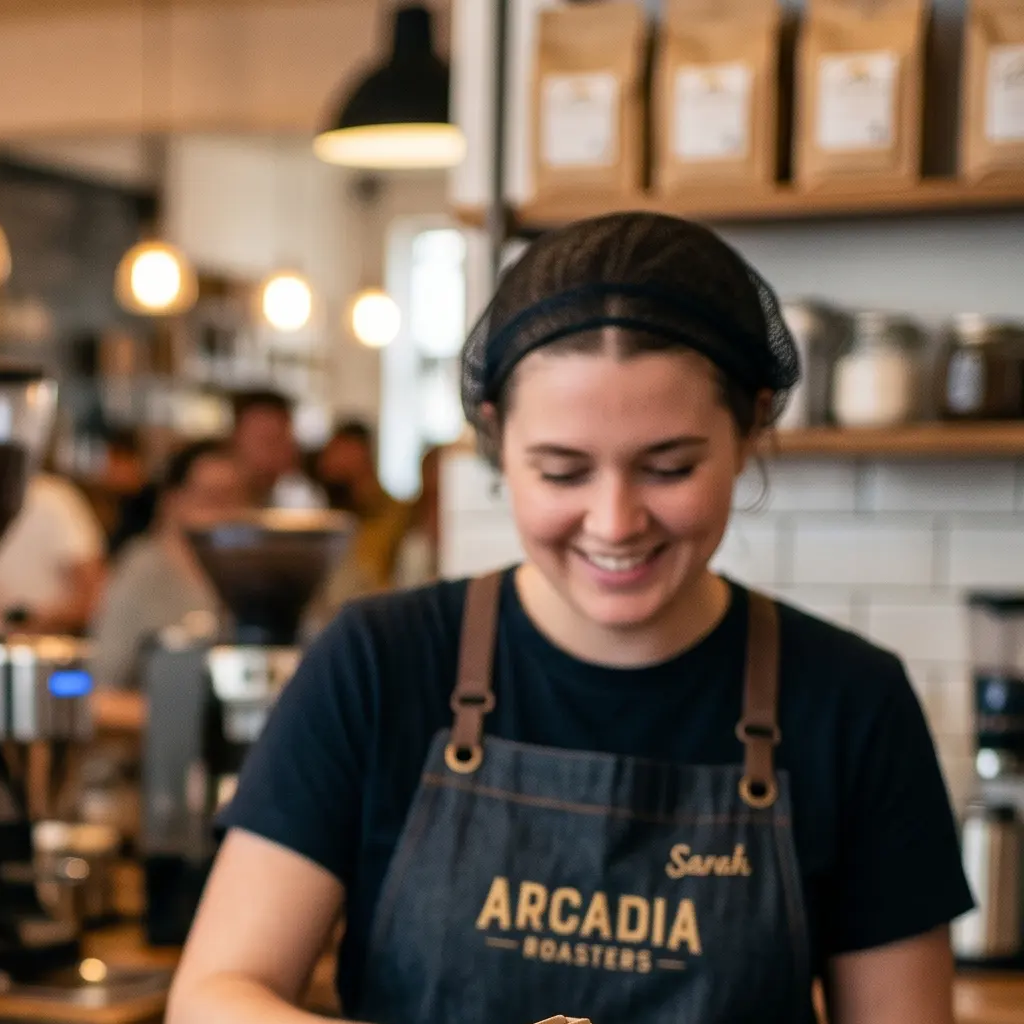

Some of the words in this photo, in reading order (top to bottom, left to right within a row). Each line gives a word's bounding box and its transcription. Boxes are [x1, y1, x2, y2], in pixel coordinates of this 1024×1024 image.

[664, 842, 752, 880] Sarah
[476, 876, 702, 956] ARCADIA
[522, 936, 652, 974] ROASTERS
